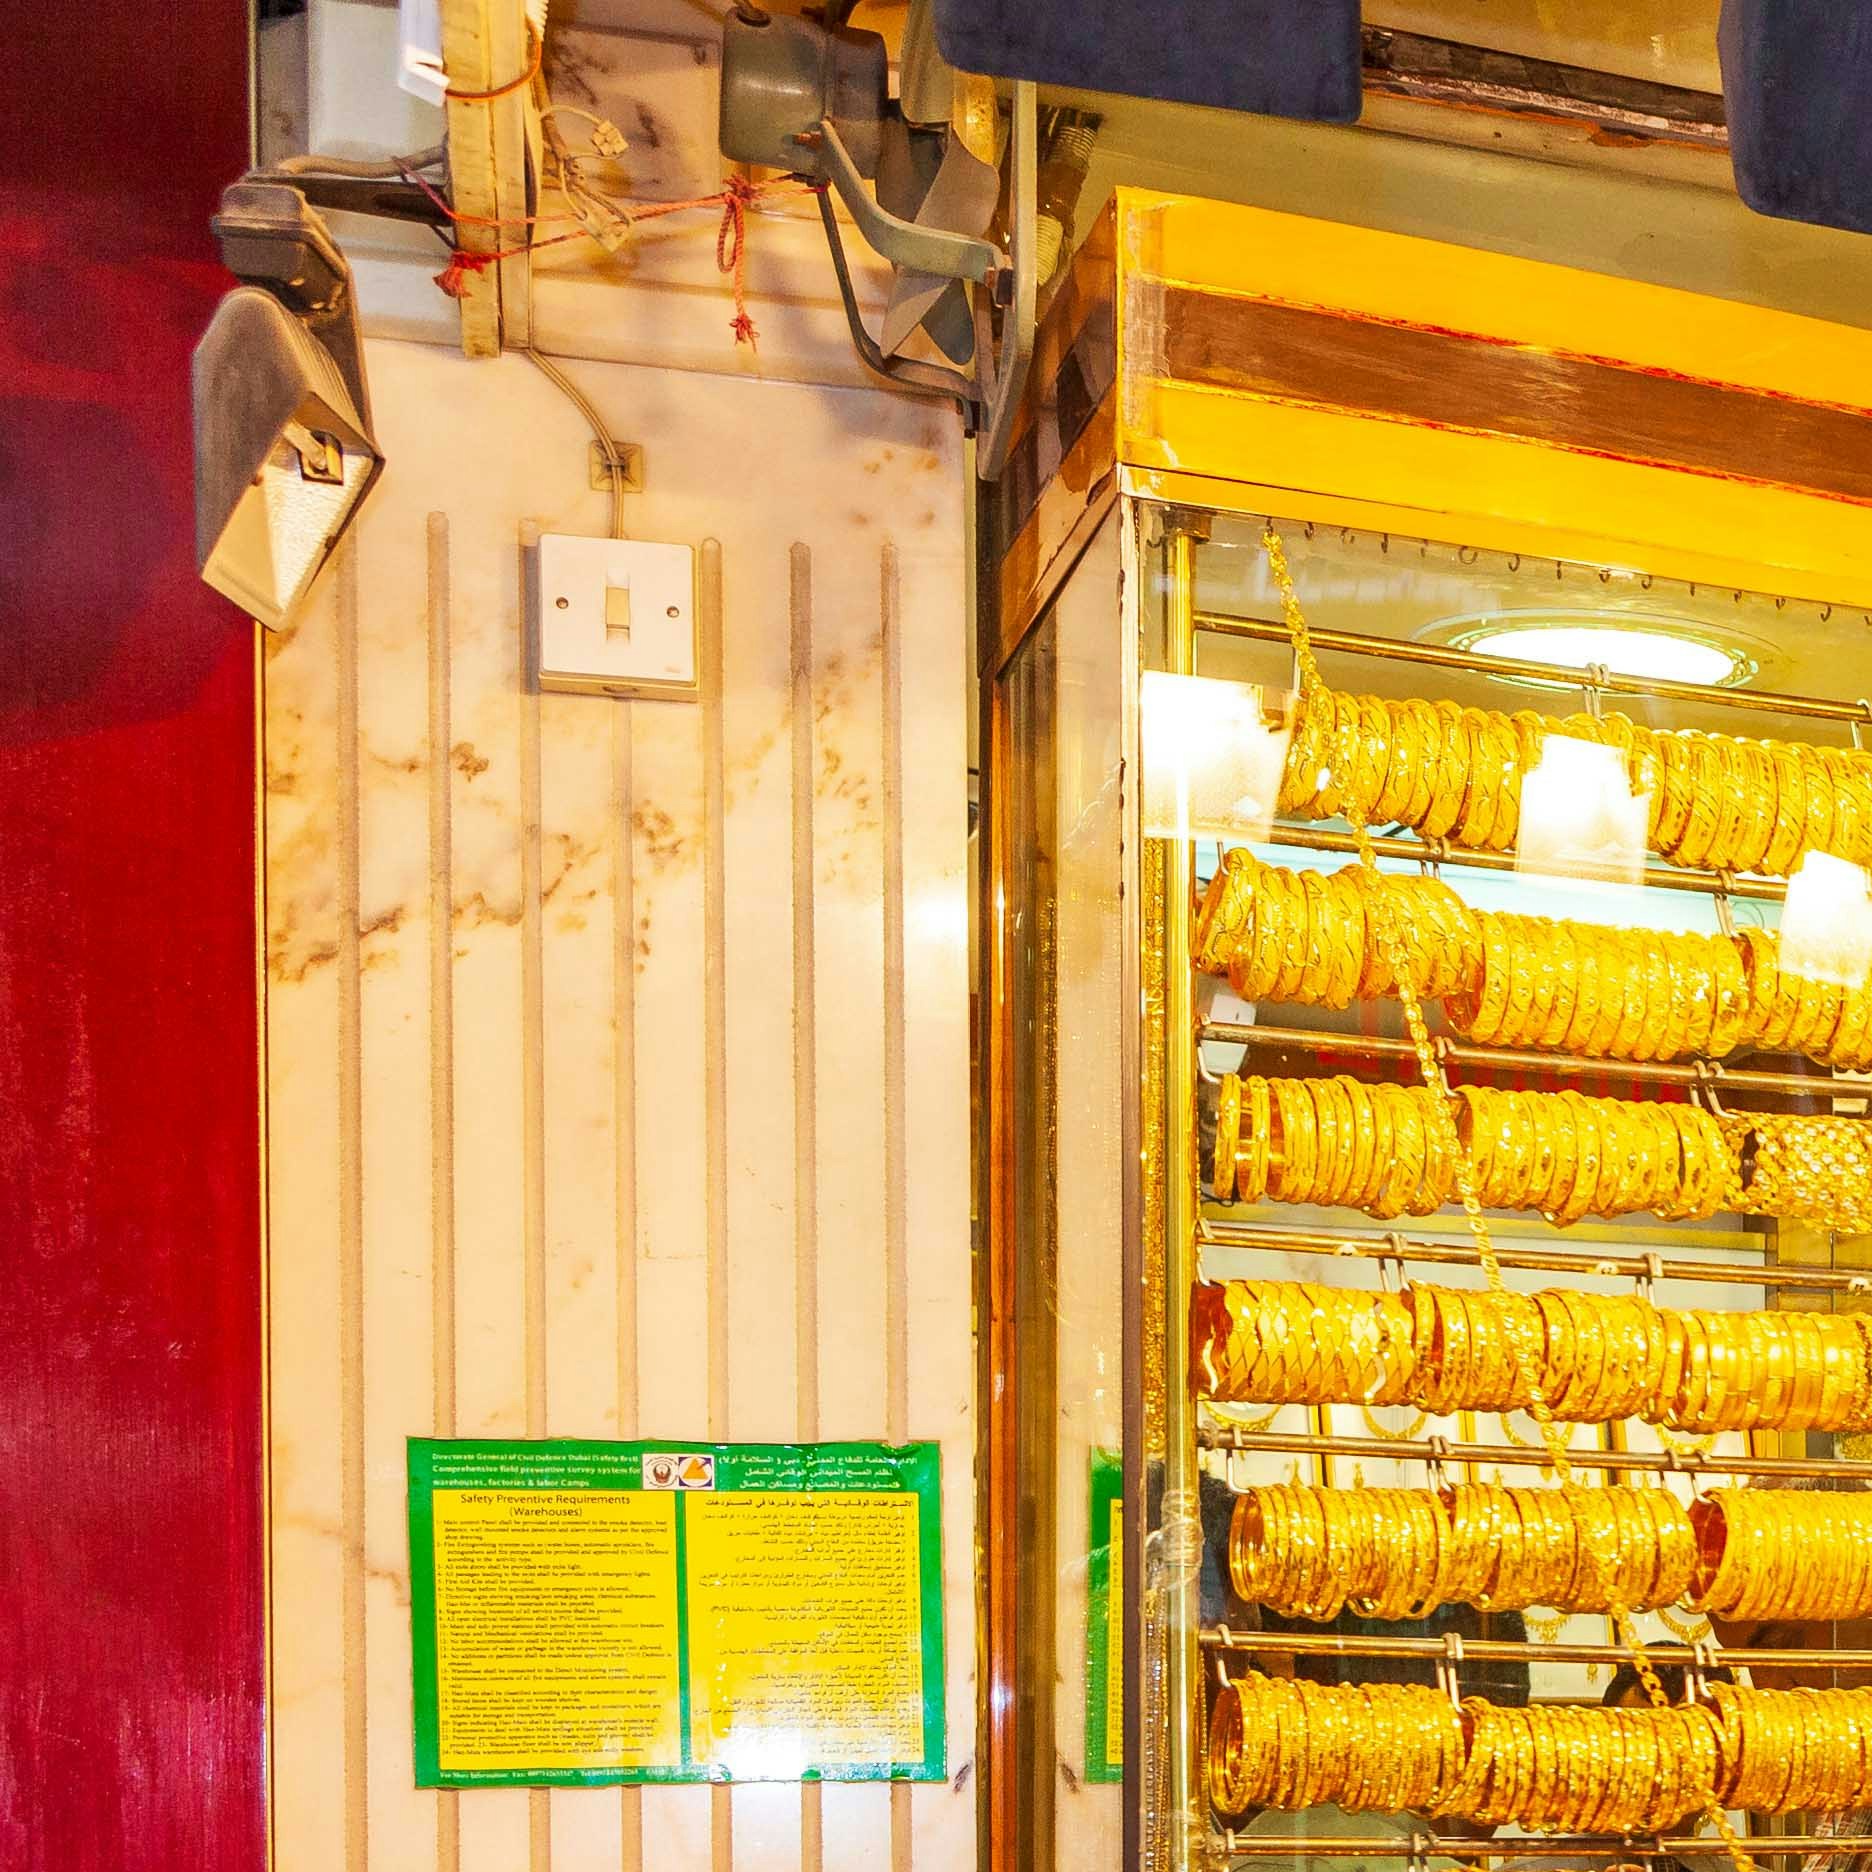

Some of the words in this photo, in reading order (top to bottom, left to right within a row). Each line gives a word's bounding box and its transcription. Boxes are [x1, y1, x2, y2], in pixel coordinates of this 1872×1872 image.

[432, 1464, 498, 1474] Comprehensive
[460, 1494, 494, 1505] Safety
[496, 1494, 553, 1504] Preventive
[555, 1494, 631, 1506] Requirements
[509, 1507, 583, 1518] (Warehouses)
